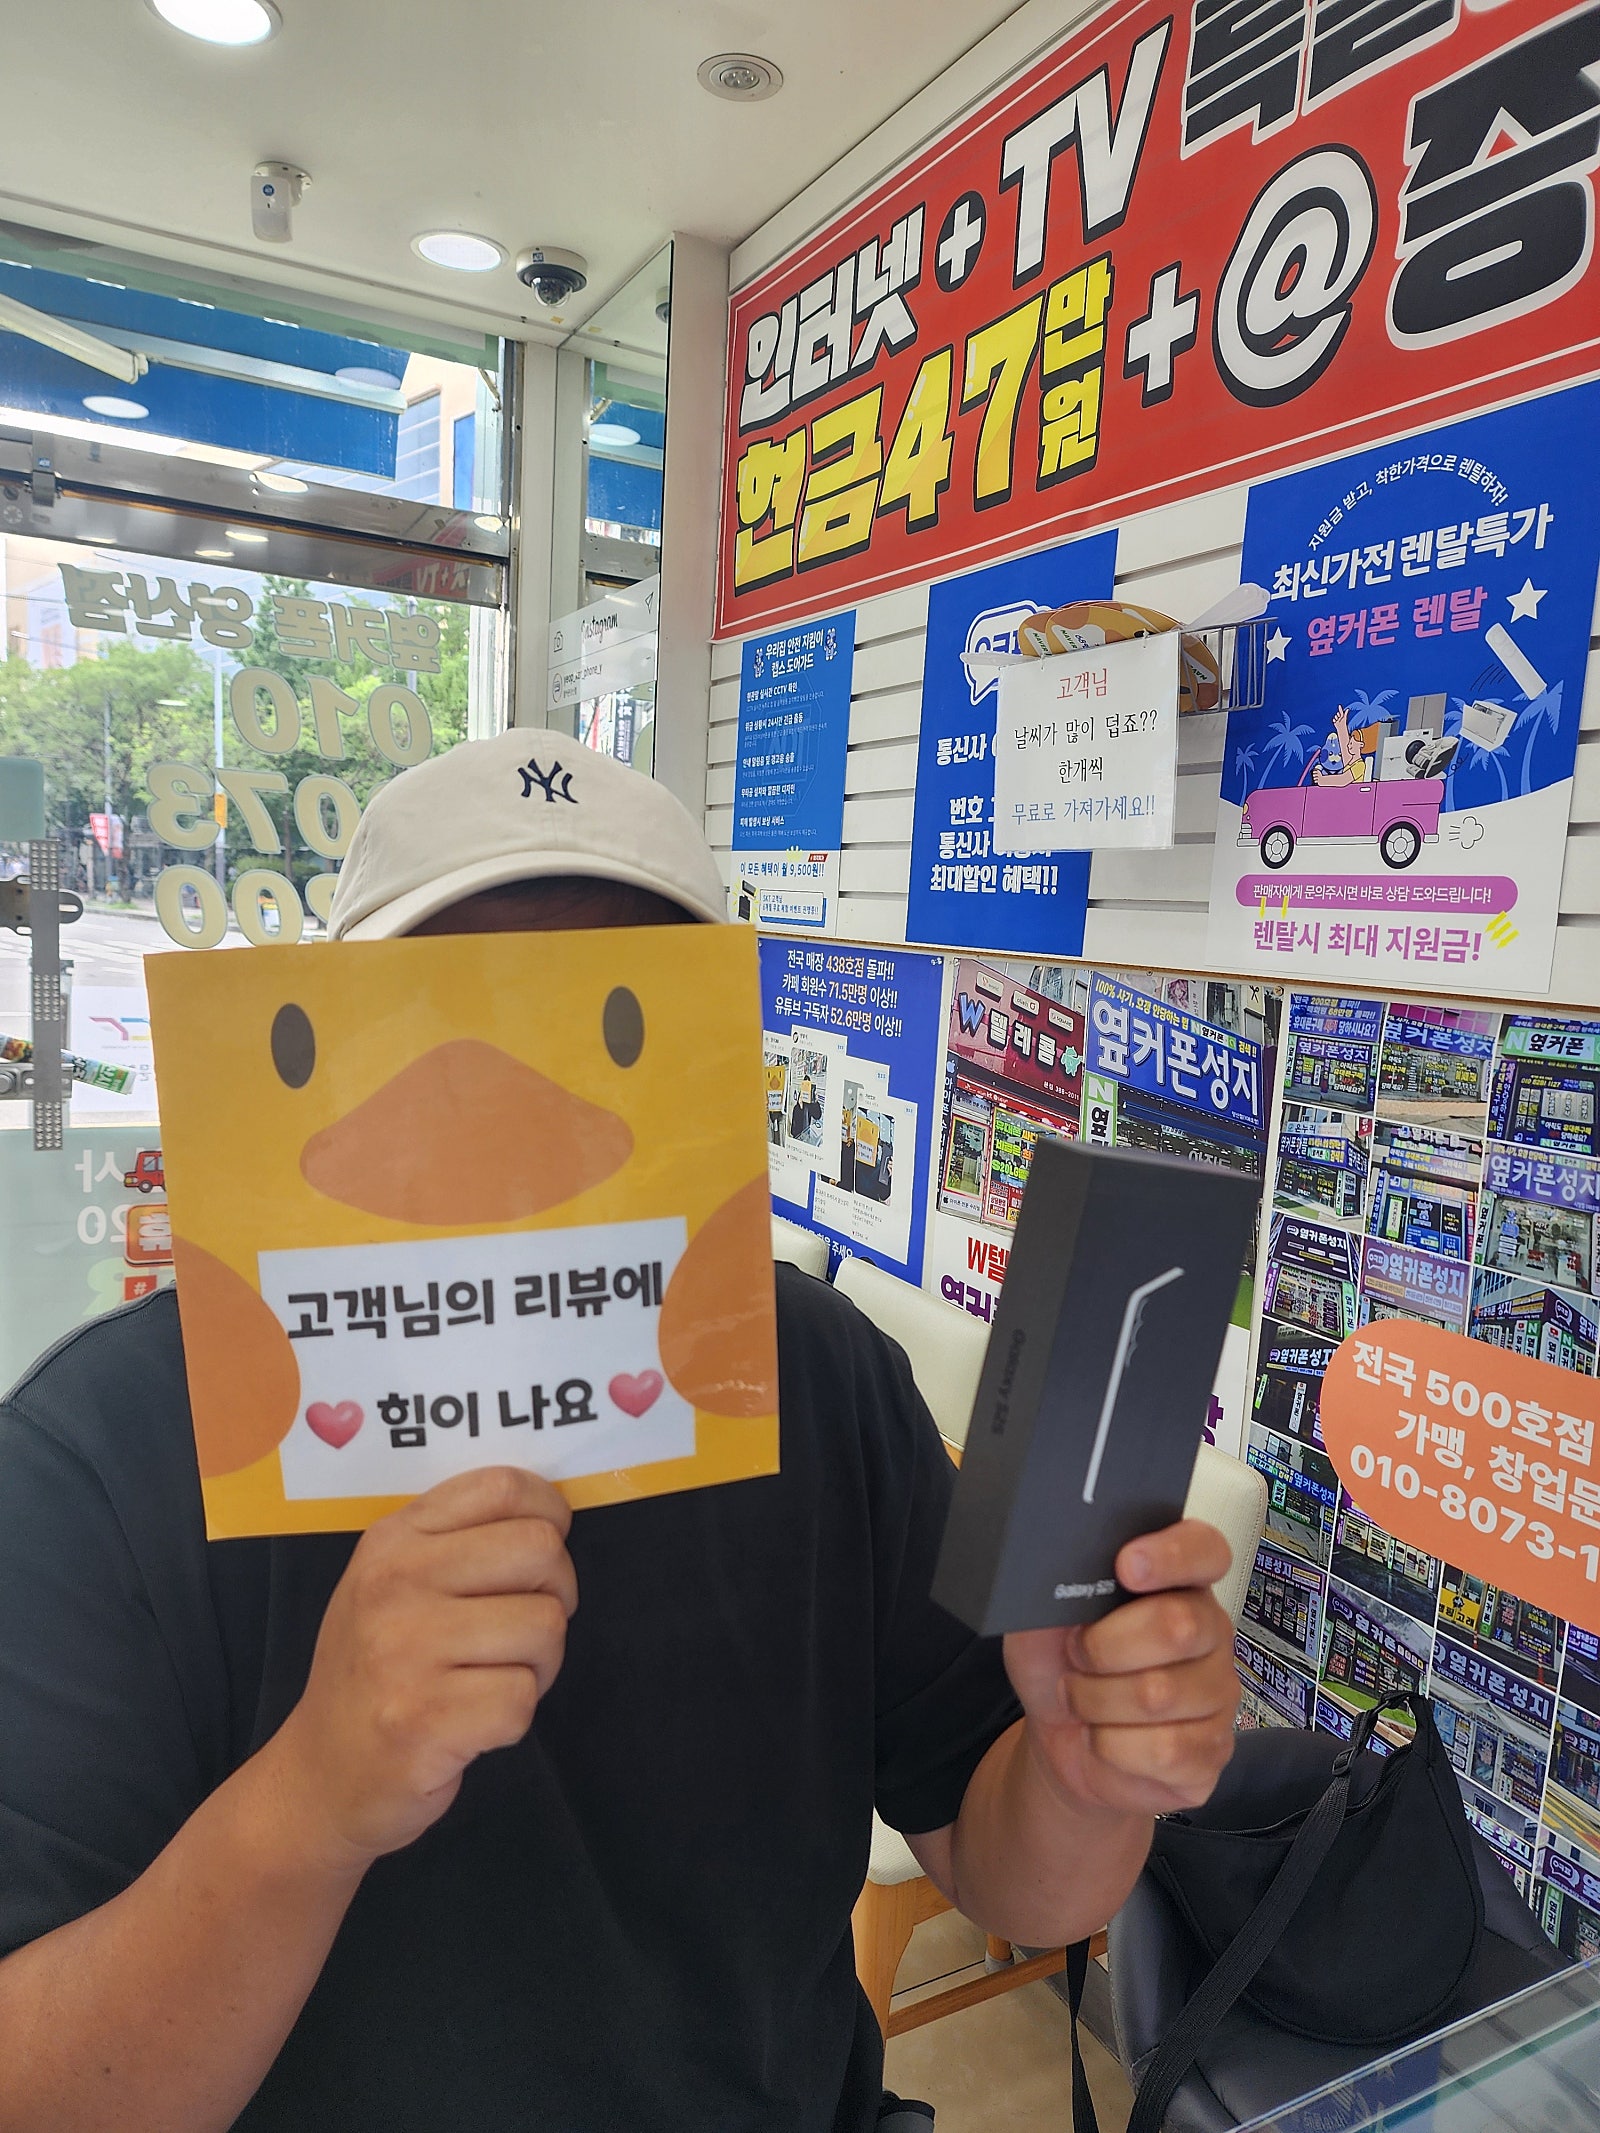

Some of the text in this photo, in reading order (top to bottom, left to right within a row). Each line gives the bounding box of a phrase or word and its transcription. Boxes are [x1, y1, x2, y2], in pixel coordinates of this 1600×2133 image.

[742, 205, 925, 428] 인터넷
[1002, 17, 1173, 286] TV
[1214, 146, 1378, 404] @
[1307, 453, 1509, 551] 지원금 받고, 착한가격으로 렌탈하자!
[1271, 503, 1554, 601] 최신가전 렌탈특가
[1307, 586, 1488, 657] 옆커폰 렌탈
[765, 629, 824, 660] 우리집 안전 지킴이
[1060, 629, 1078, 649] NAVER
[771, 653, 814, 678] 캡스 도어가드
[774, 683, 788, 697] CCTV
[1056, 667, 1108, 700] 고객님
[1014, 709, 1158, 750] 날씨가 많이 덥죠??
[936, 733, 988, 766] 통신사
[1058, 756, 1104, 784] 한개씩
[949, 797, 984, 825] 번호
[1011, 795, 1156, 826] 무료로 가져가세요!!
[938, 831, 990, 860] 통신사
[740, 864, 746, 875] 이
[748, 864, 759, 876] 모든
[761, 863, 779, 876] 혜택이
[930, 864, 1059, 896] 최대할인 혜택!!
[1304, 885, 1358, 901] 문의주시면
[1360, 886, 1384, 901] 바로
[1385, 887, 1410, 902] 상담
[1411, 887, 1492, 904] 도와드립니다!
[1253, 920, 1483, 964] 렌탈시 최대 지원금!
[787, 949, 895, 981] 전국 매장 438호점 돌파!!
[782, 973, 898, 1009] 카페 회원수 71.5만명 이상!!
[774, 996, 903, 1038] 유튜브 구독자 52.6만명 이상!!
[1095, 979, 1116, 1000] 100%
[1117, 988, 1135, 1007] 사기,
[1135, 997, 1152, 1014] 호갱
[1152, 1003, 1181, 1028] 안당하는
[1201, 1026, 1225, 1043] 옆커폰
[1092, 999, 1259, 1116] 옆커폰성지
[1298, 1041, 1369, 1064] 옆커폰성지
[1528, 1033, 1585, 1056] 옆커폰
[1491, 1155, 1600, 1202] 옆커폰성지
[287, 1261, 665, 1340] 고객님의 리뷰에
[377, 1378, 599, 1449] 힘이 나요
[1352, 1340, 1595, 1466] 전국 500호점
[1394, 1409, 1475, 1481] 가맹,
